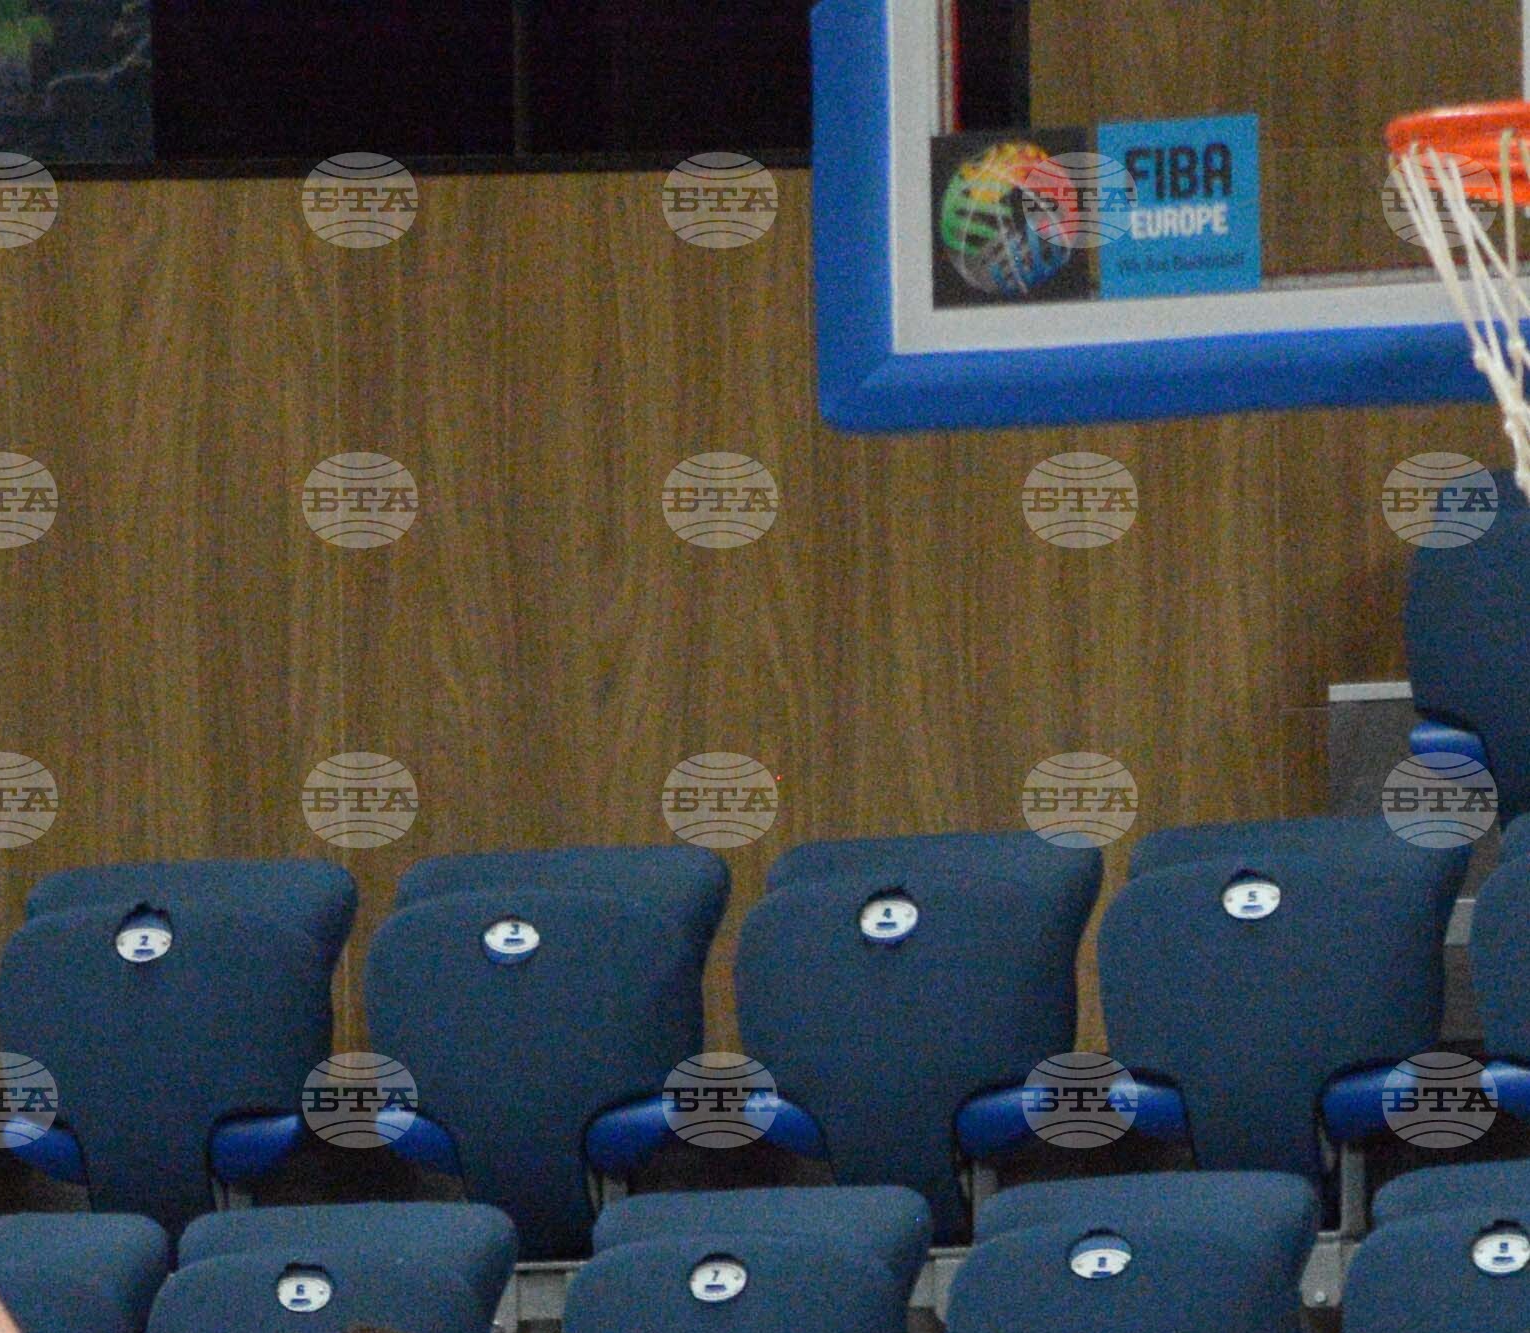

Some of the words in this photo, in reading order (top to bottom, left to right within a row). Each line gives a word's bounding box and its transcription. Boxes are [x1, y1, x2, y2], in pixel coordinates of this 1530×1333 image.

[1124, 142, 1232, 200] FIBA
[1131, 202, 1229, 241] EUROPE
[1248, 890, 1258, 902] 5
[140, 935, 150, 946] 2
